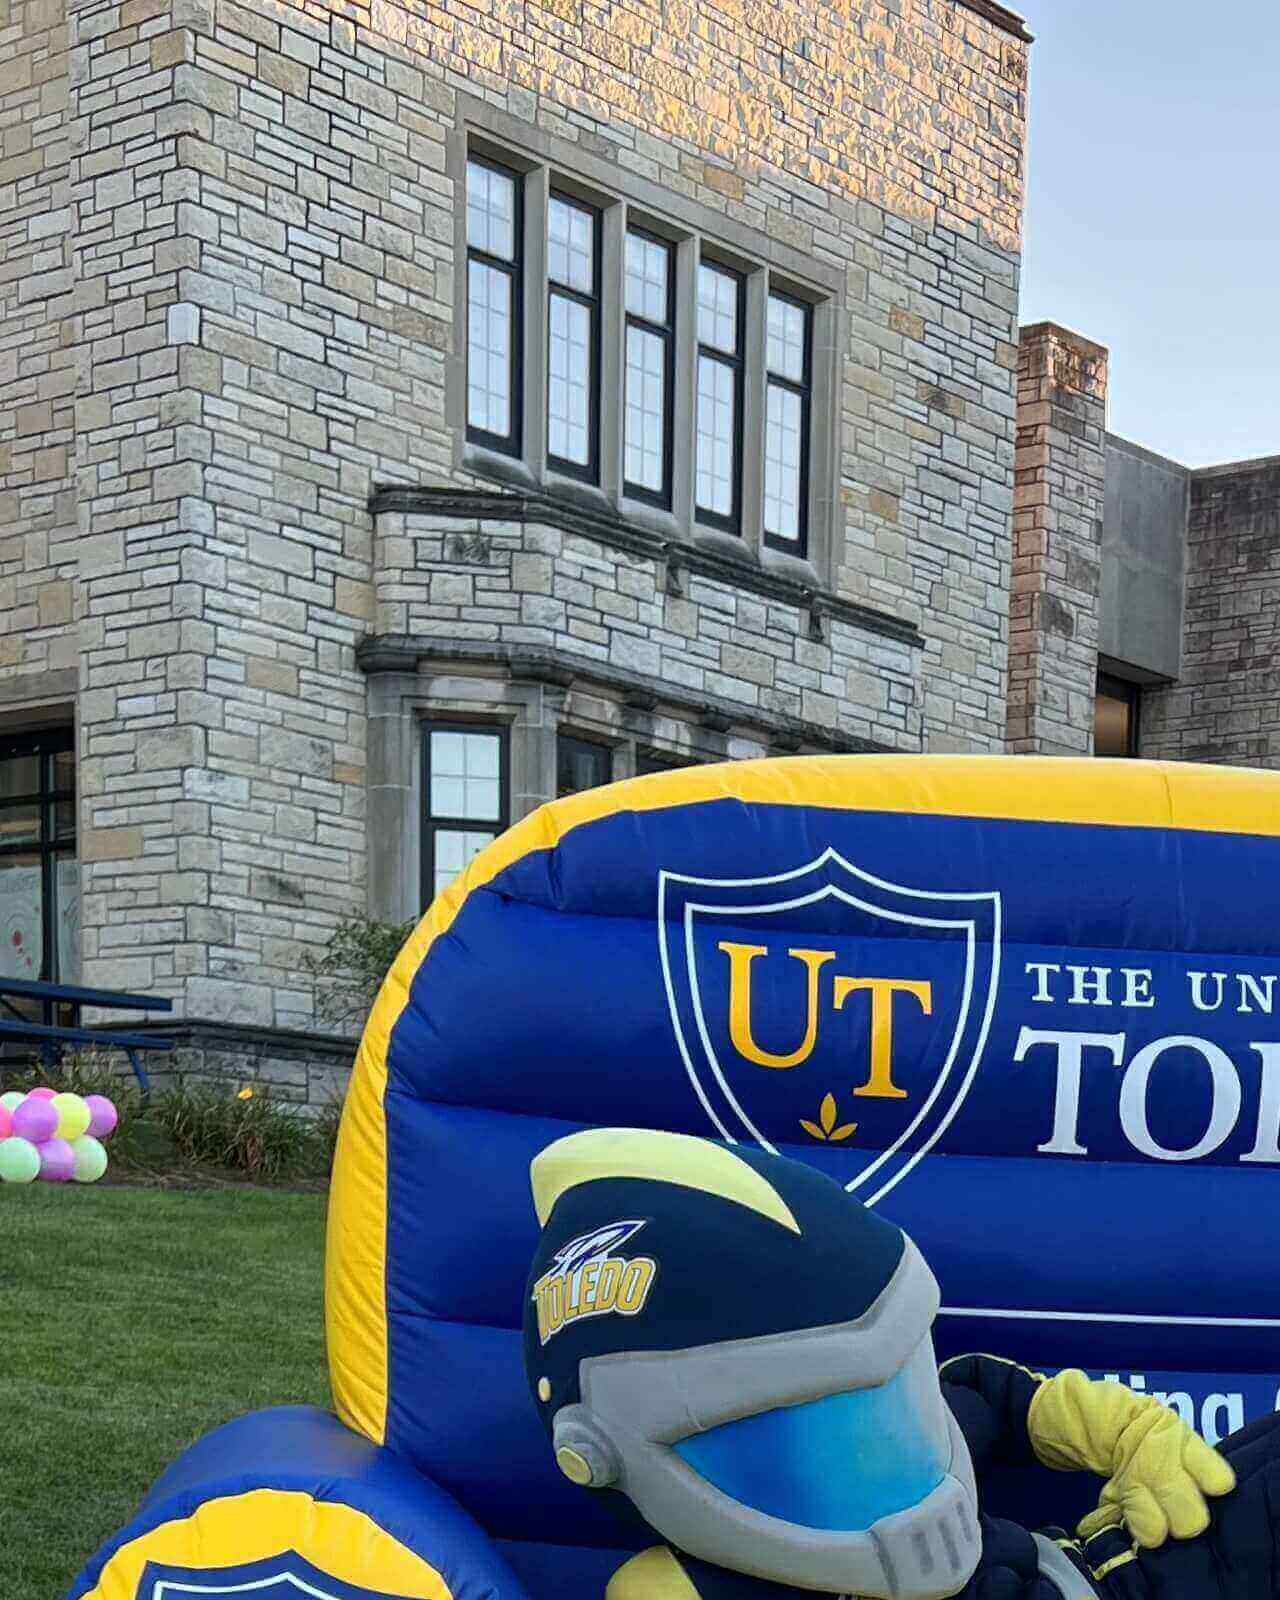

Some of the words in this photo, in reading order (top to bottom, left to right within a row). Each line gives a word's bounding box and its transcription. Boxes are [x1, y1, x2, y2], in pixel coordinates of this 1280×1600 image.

[717, 940, 933, 1099] UT
[1024, 961, 1156, 1008] THE
[531, 1256, 657, 1346] TOLEDO
